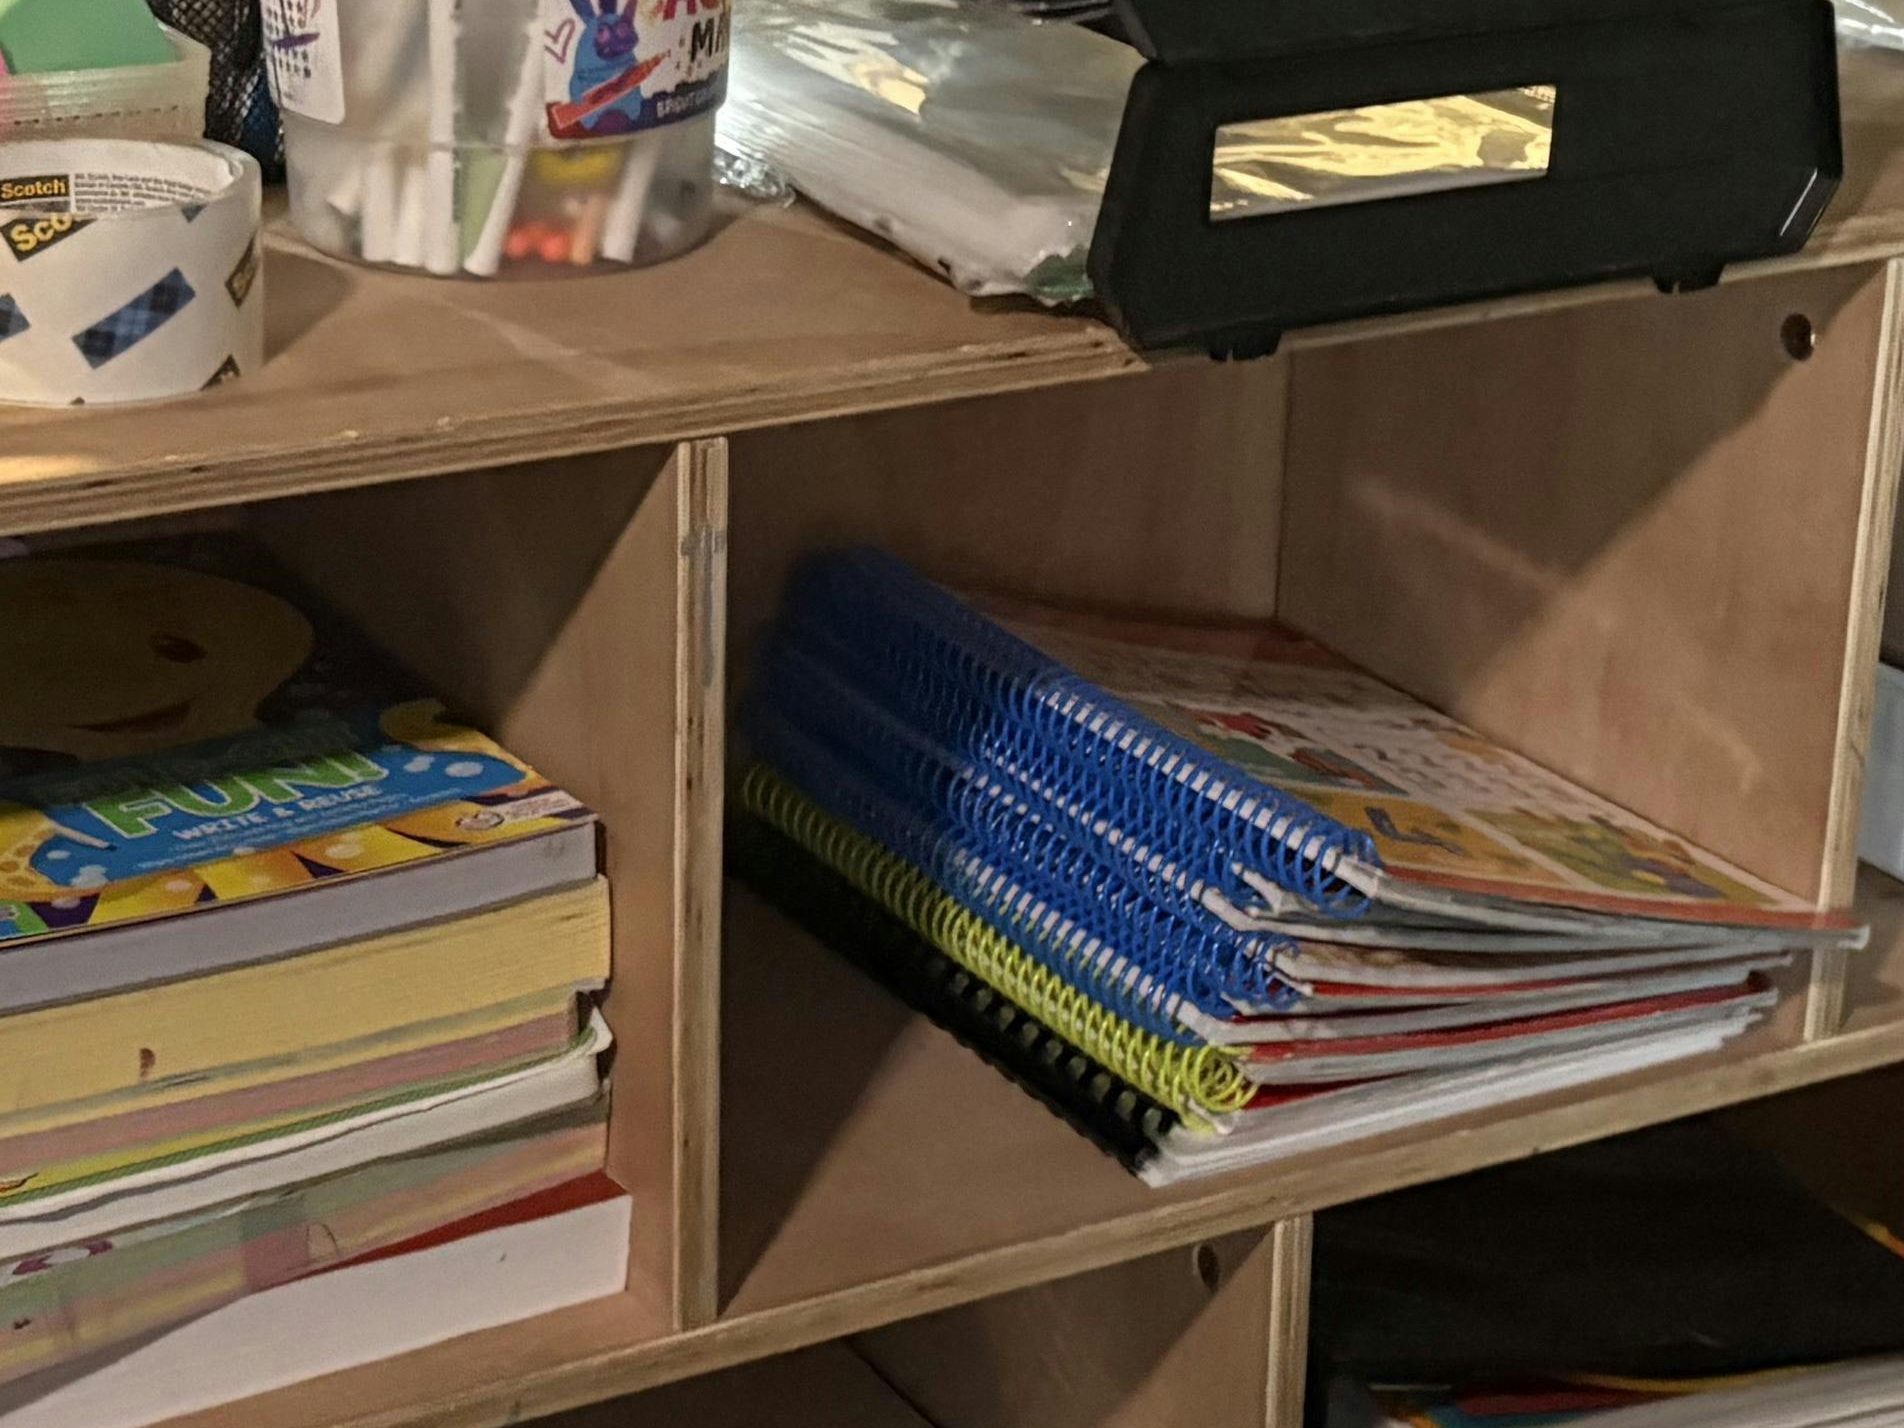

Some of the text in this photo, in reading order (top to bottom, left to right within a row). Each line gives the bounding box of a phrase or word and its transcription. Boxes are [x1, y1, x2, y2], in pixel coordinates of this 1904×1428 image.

[1, 179, 67, 201] Scotch
[9, 212, 79, 253] Sco
[172, 811, 270, 842] WRITE
